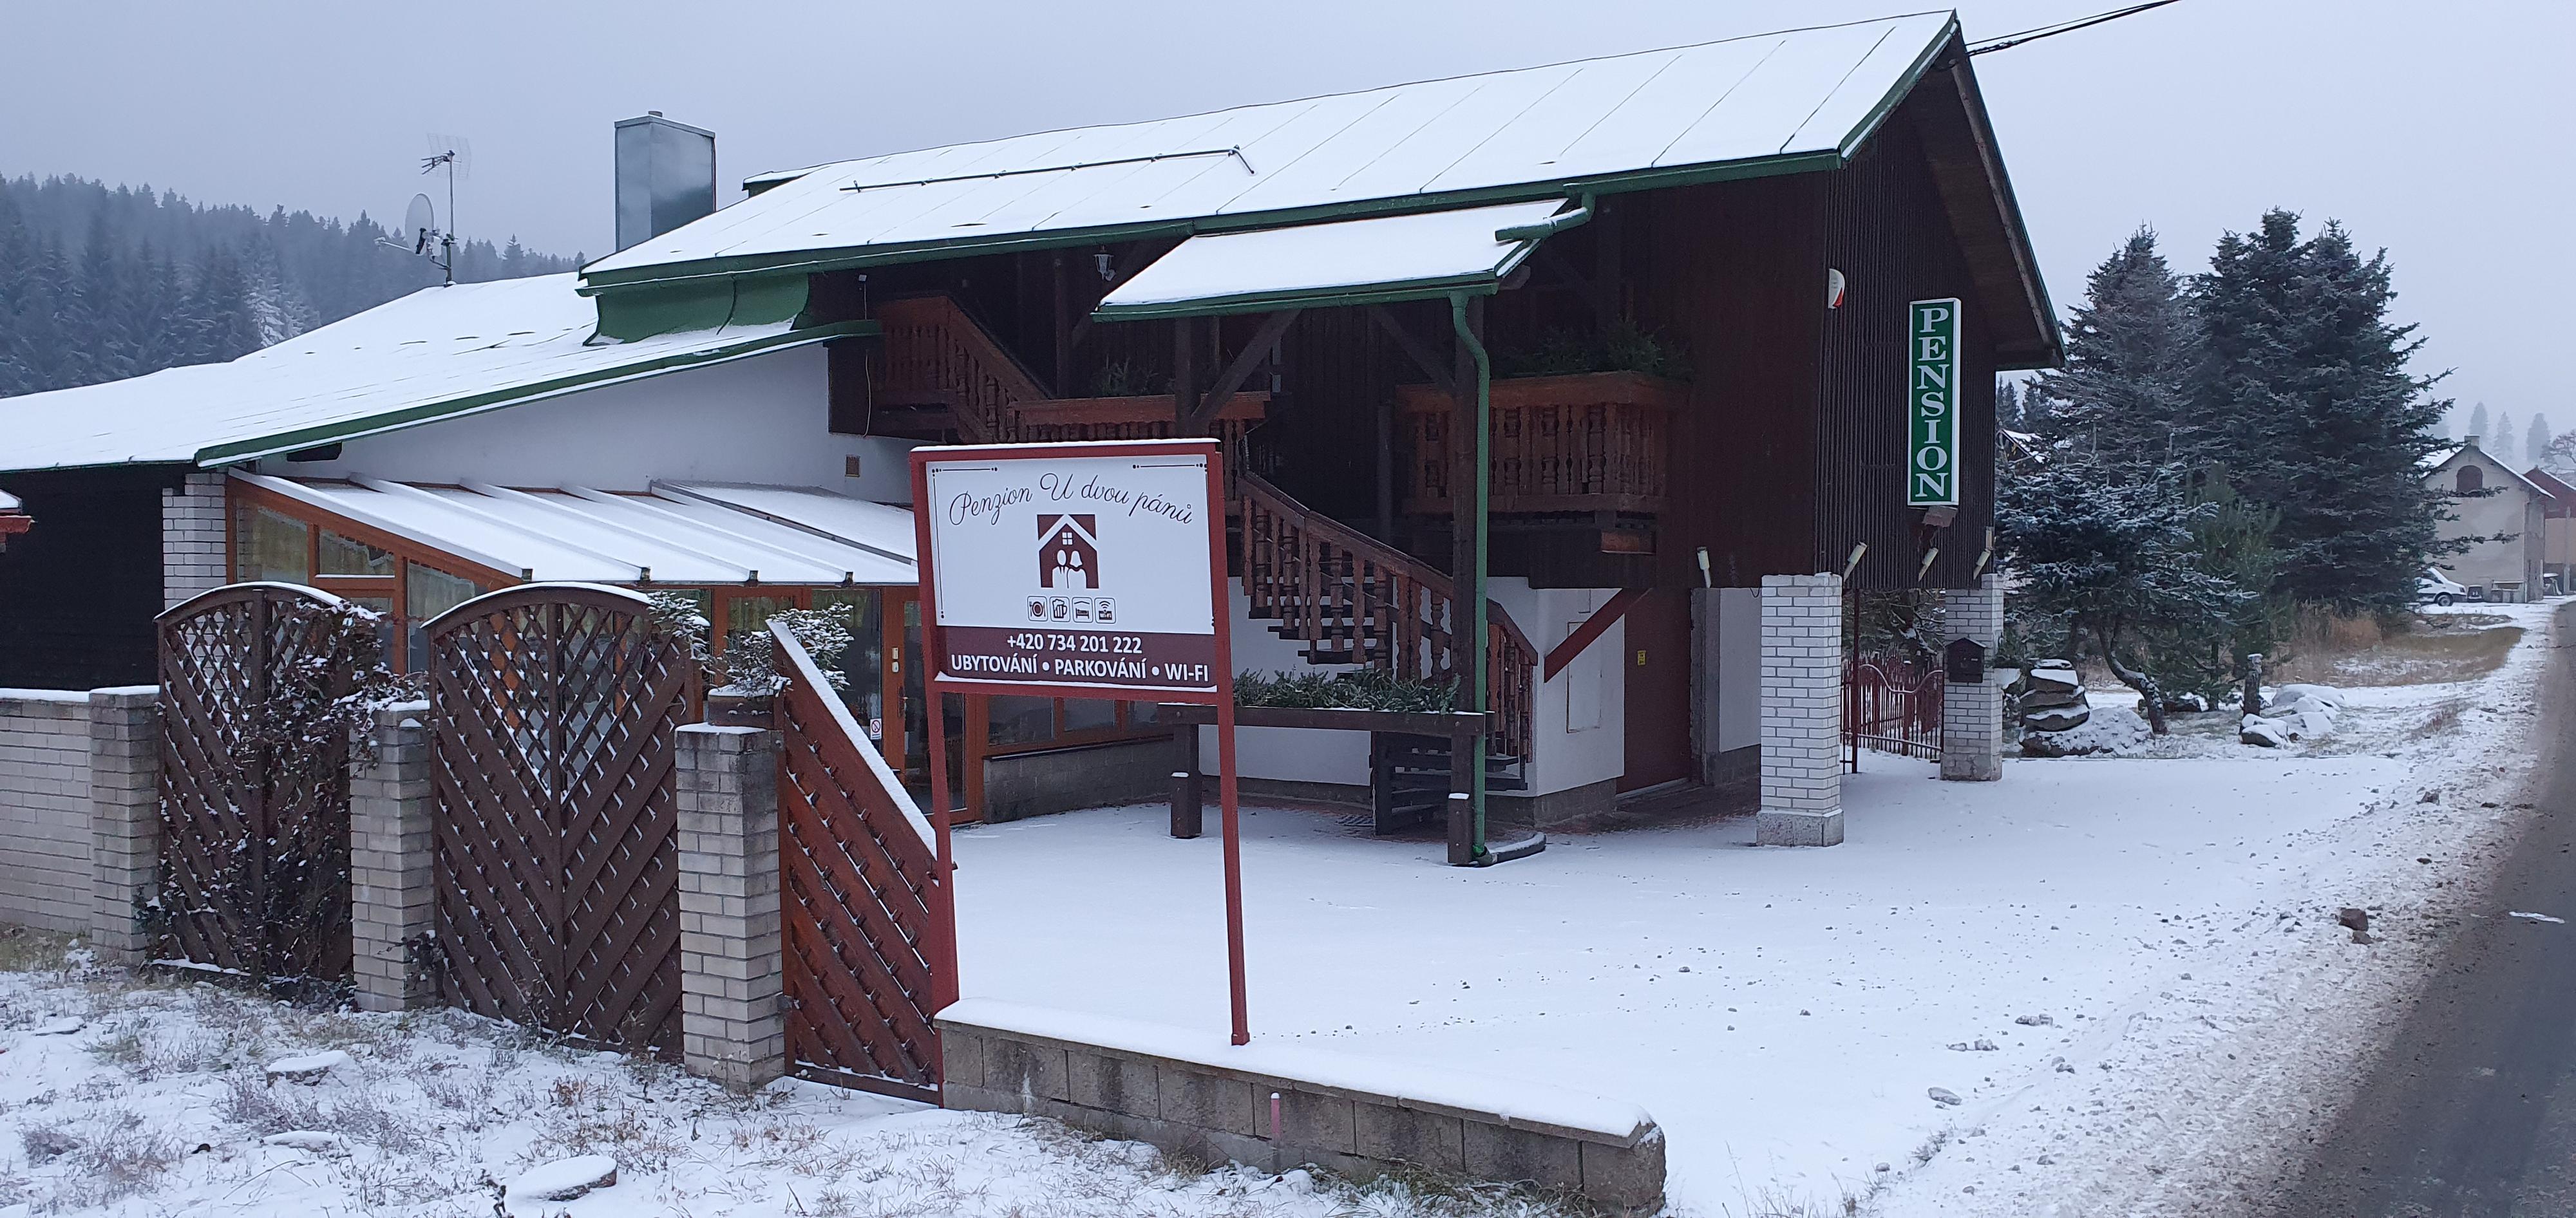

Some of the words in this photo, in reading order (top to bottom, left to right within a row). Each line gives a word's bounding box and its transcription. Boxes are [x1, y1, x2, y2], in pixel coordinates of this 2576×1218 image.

[1915, 307, 1949, 498] PENSION
[949, 487, 1032, 525] Penzion
[1040, 473, 1074, 501] U
[1081, 474, 1130, 504] dvou
[1128, 492, 1193, 524] pánů
[1007, 633, 1044, 650] +420
[1047, 634, 1076, 651] 734
[1079, 635, 1109, 652] 201
[1113, 636, 1142, 653] 222
[951, 653, 1037, 673] UBYTOVÁNÍ
[1055, 657, 1146, 679] PARKOVÁNÍ
[1164, 663, 1209, 682] WI-FI
